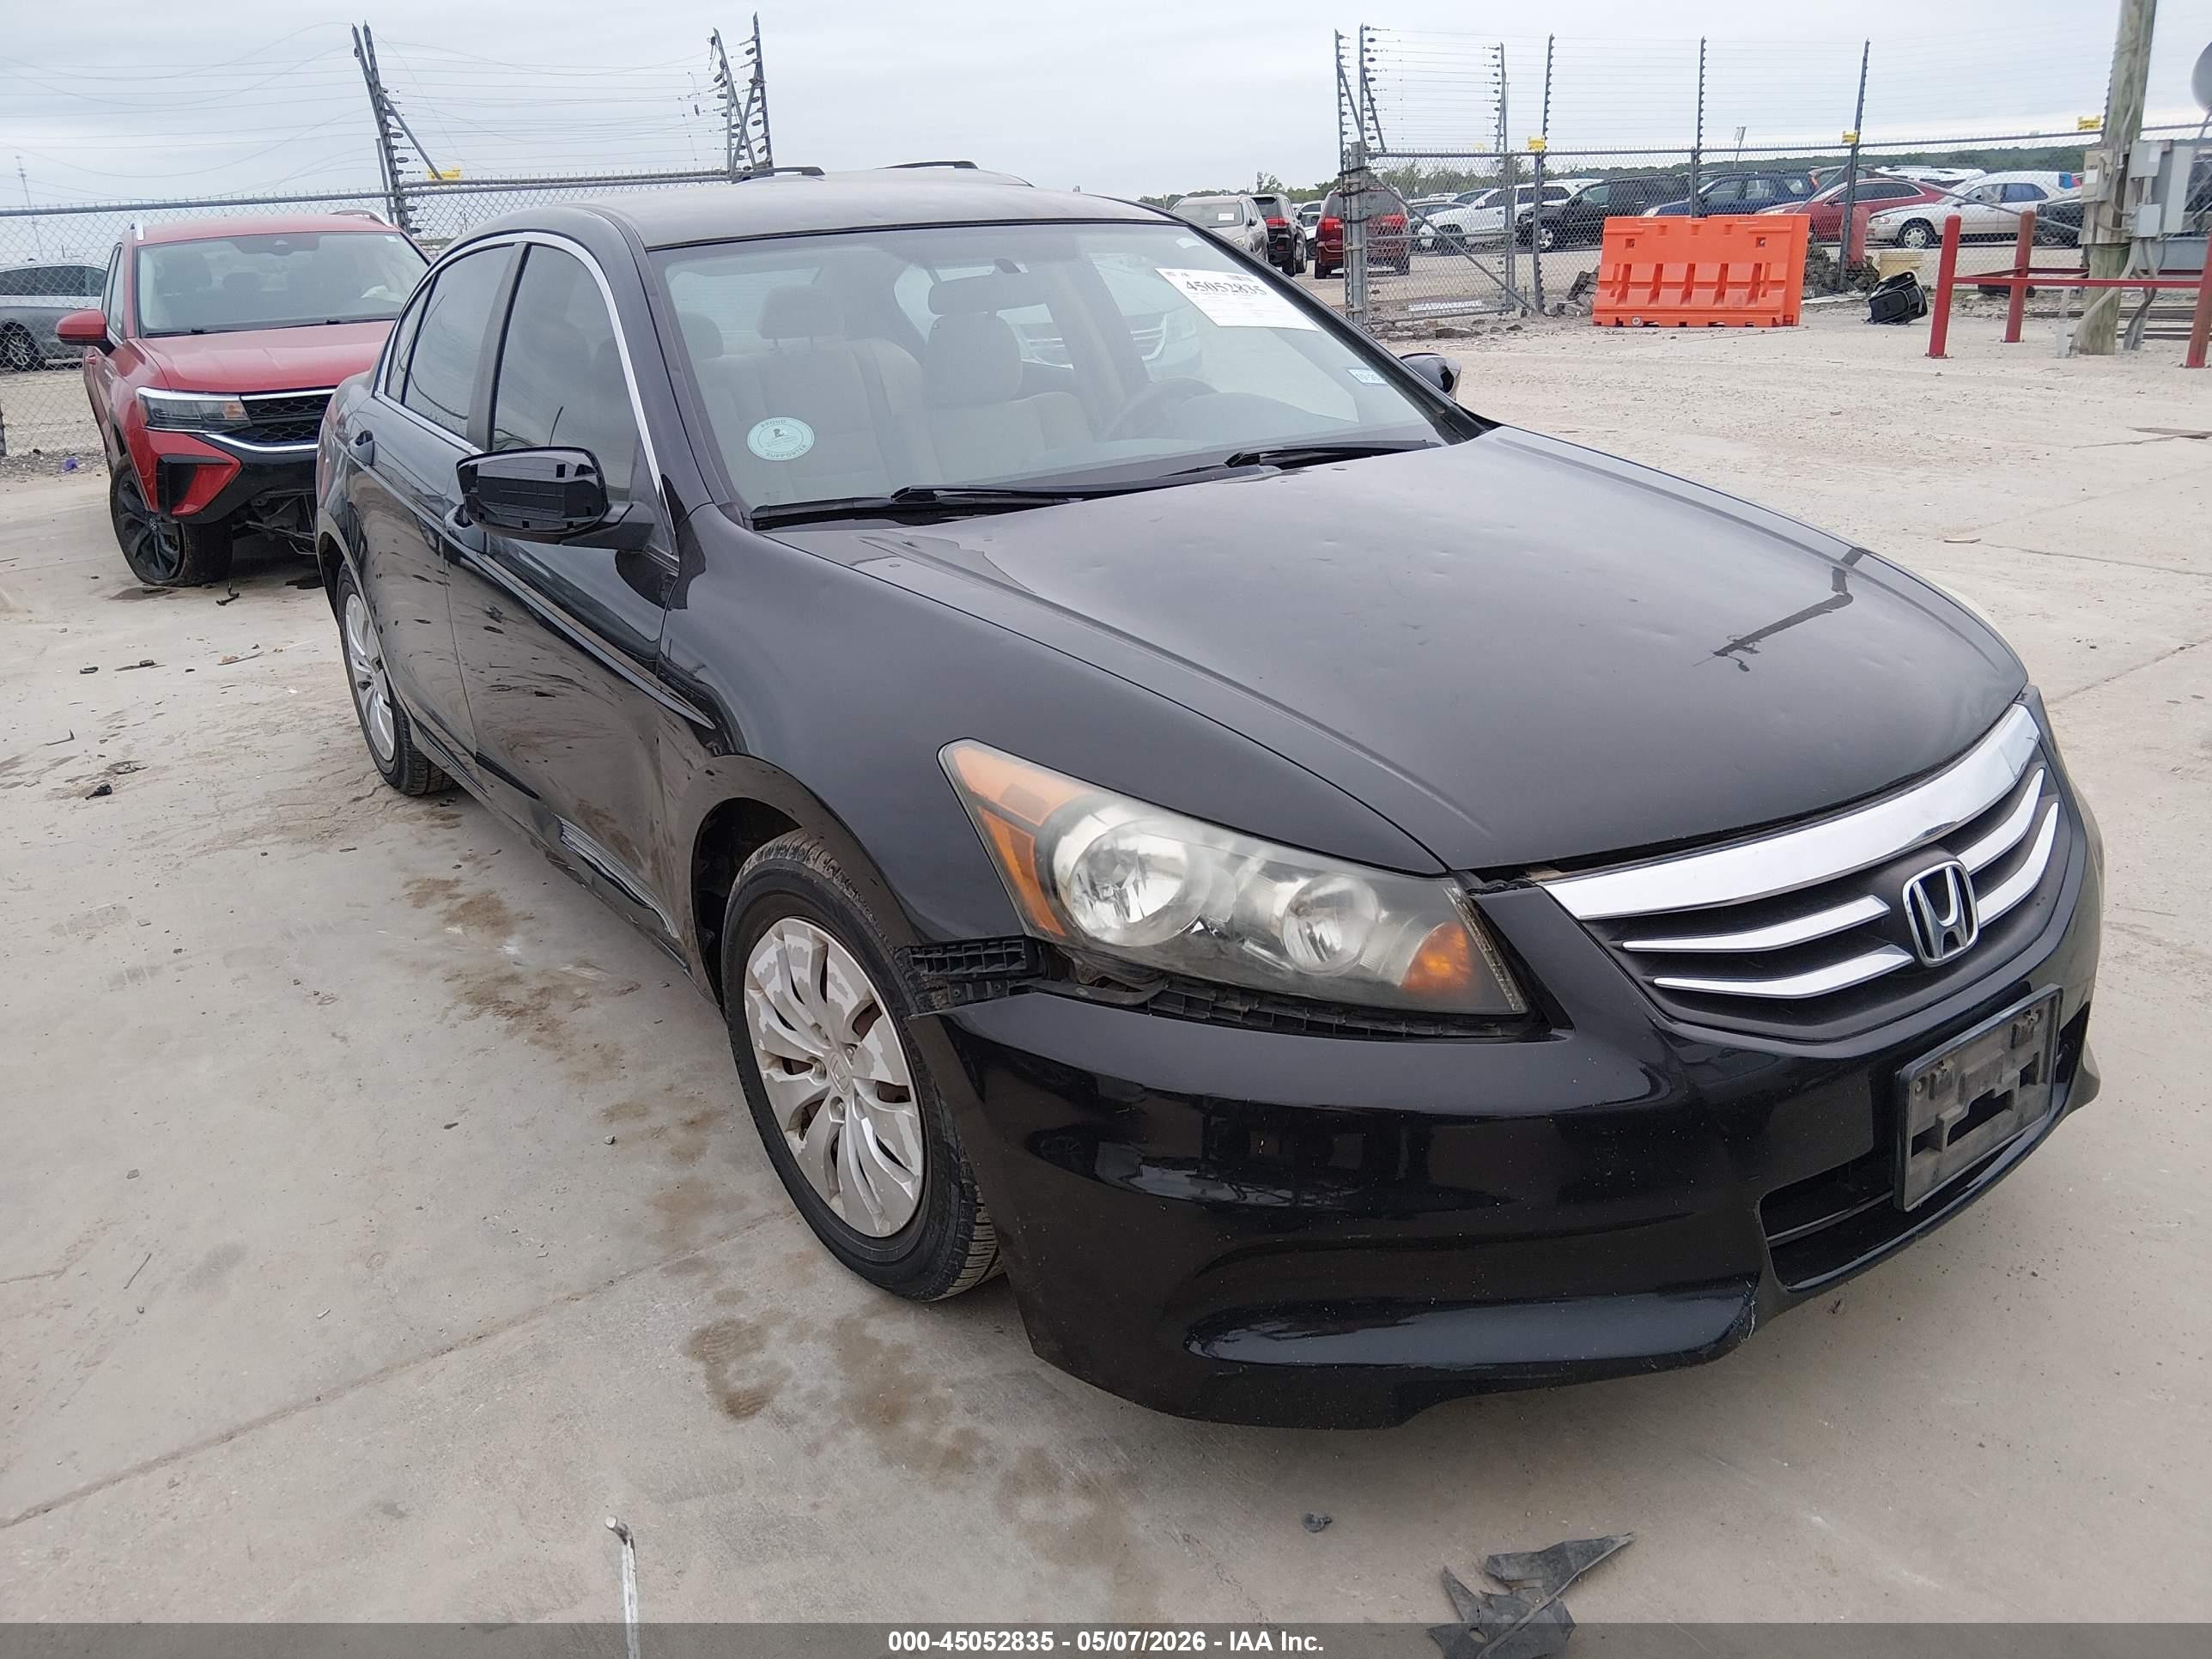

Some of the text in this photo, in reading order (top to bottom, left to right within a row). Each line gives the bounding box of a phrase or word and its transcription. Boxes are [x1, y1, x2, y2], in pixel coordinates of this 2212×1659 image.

[1186, 281, 1267, 295] 45052835
[760, 419, 787, 428] PROUD
[766, 444, 808, 459] SUPPORTER
